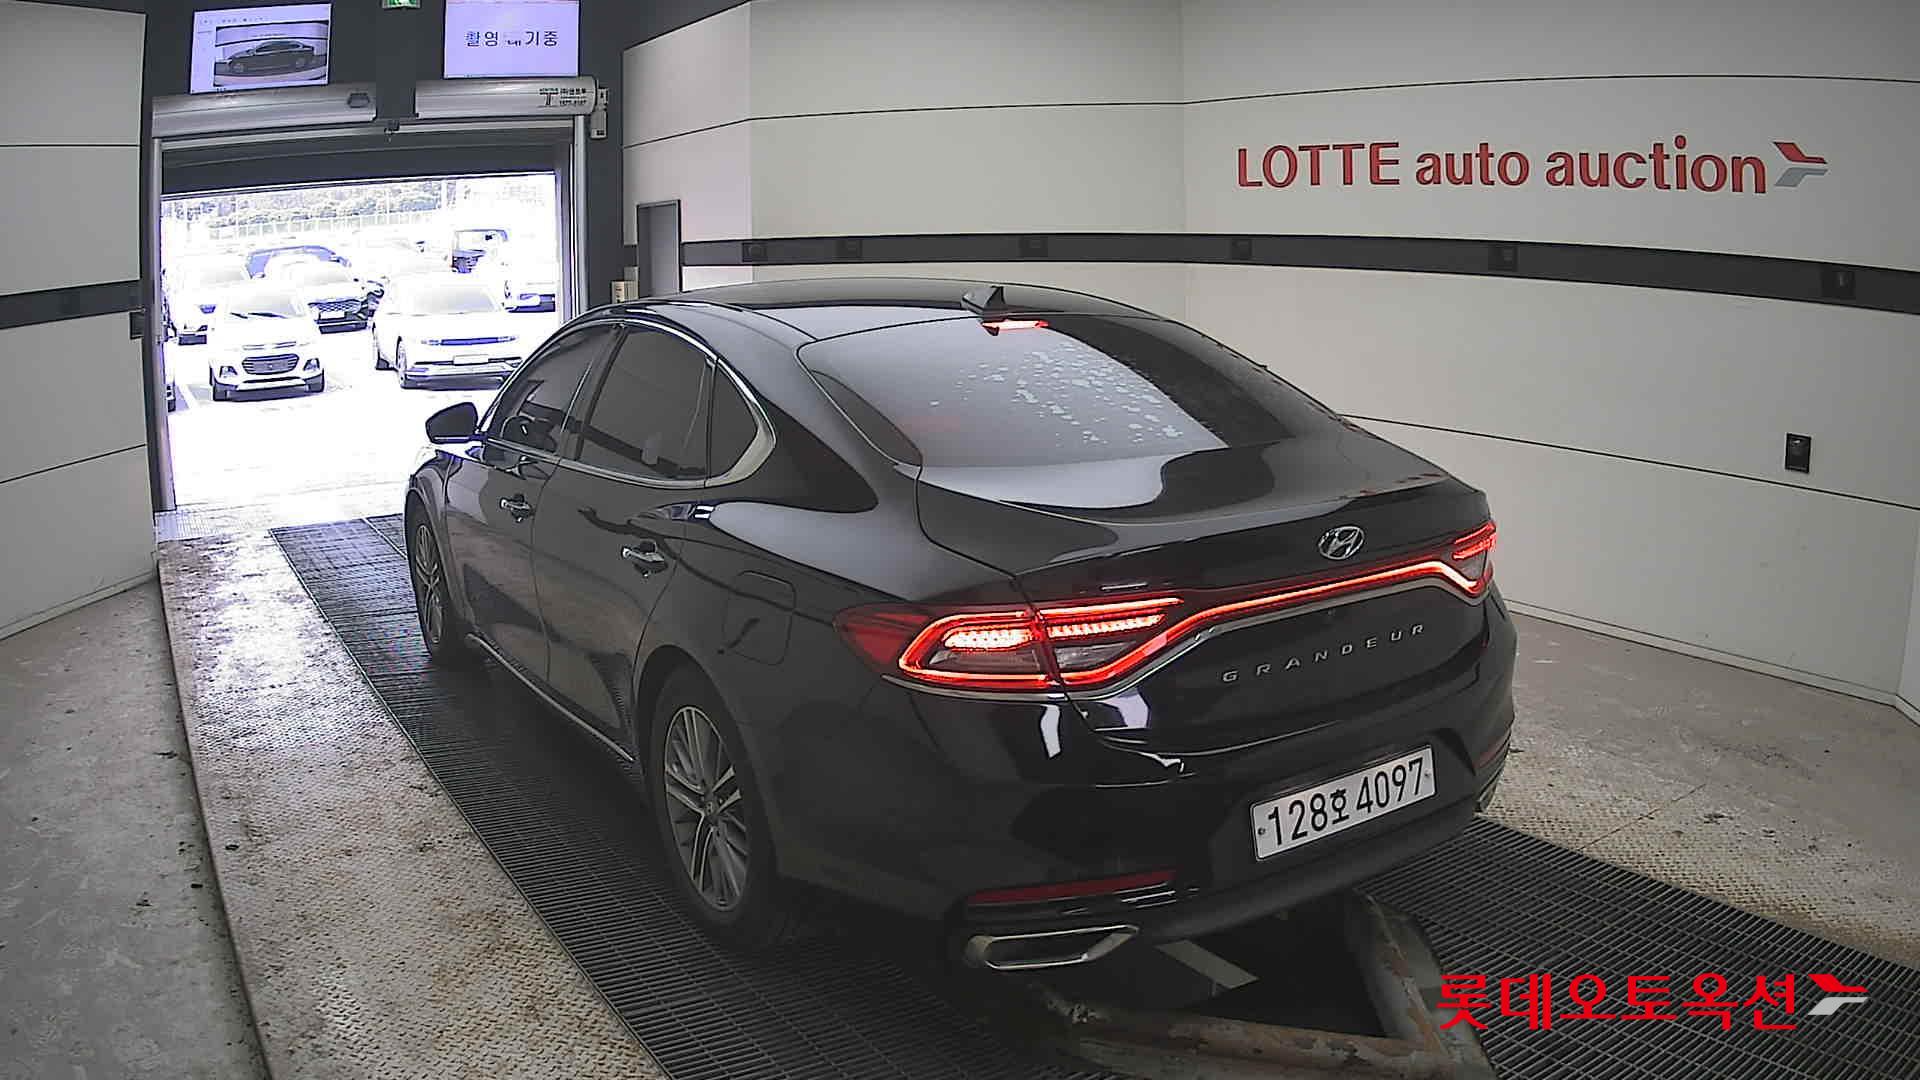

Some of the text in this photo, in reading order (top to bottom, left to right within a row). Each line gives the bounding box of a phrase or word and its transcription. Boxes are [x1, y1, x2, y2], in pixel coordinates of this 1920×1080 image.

[1237, 135, 1767, 194] LOTTE auto auction
[1222, 624, 1424, 682] GRANDEUR
